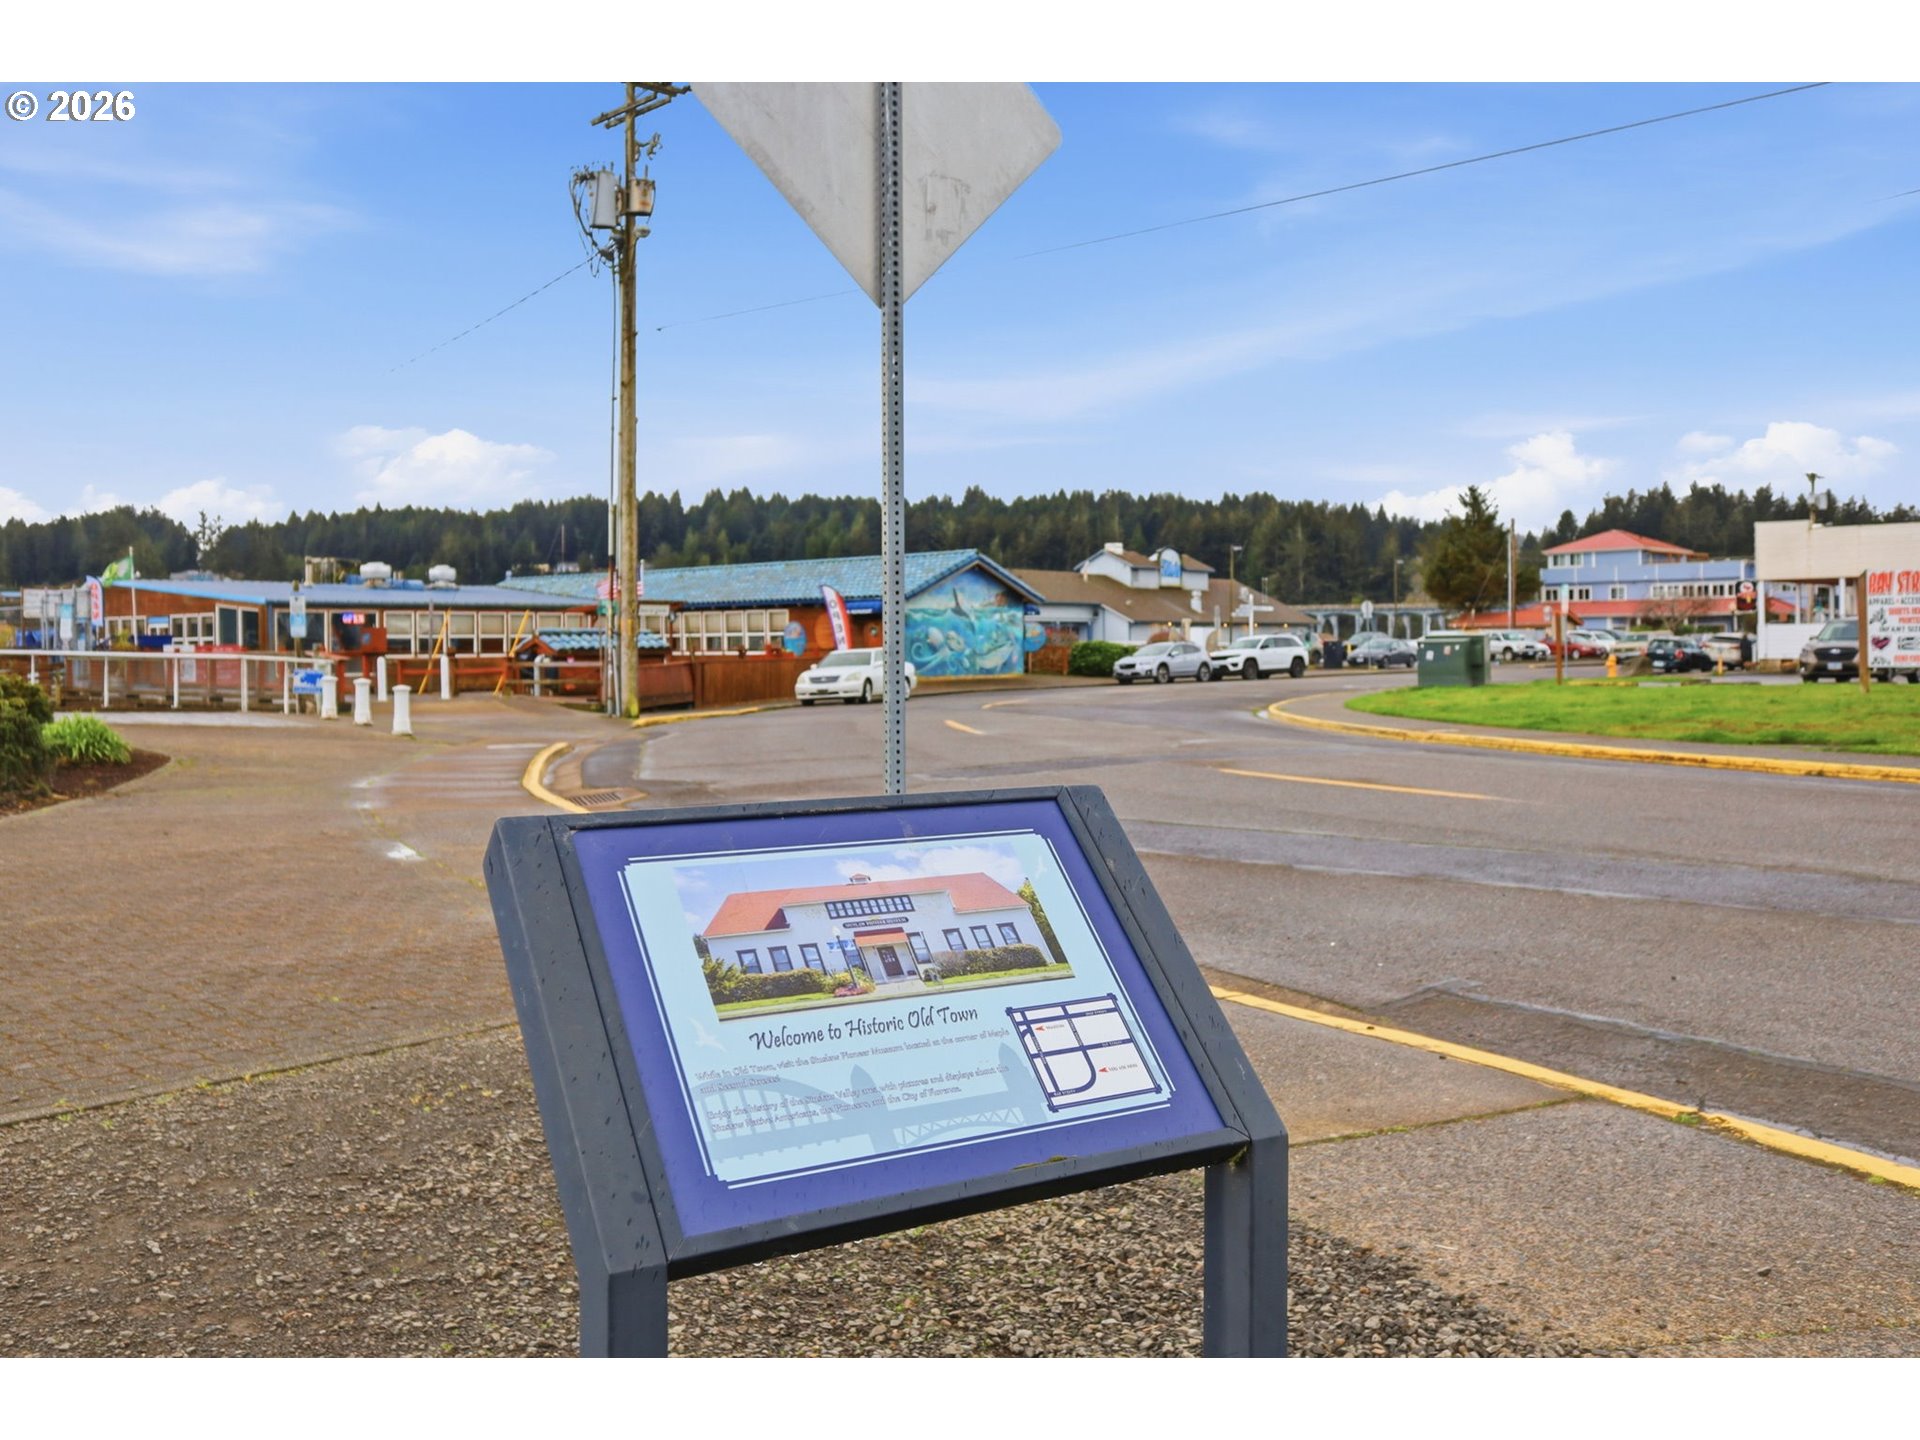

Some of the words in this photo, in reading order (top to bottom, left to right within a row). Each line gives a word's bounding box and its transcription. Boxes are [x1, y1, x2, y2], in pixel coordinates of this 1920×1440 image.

[749, 1026, 824, 1050] Welcome
[828, 1023, 842, 1040] to
[844, 1016, 904, 1038] Historic
[908, 1006, 935, 1028] Old
[936, 1006, 978, 1024] Town
[733, 1066, 748, 1076] Old
[750, 1064, 777, 1073] Town,
[798, 1058, 810, 1068] the
[904, 1039, 930, 1050] located
[941, 1036, 954, 1045] the
[979, 1030, 988, 1040] of
[733, 1106, 747, 1116] the
[779, 1098, 788, 1108] of
[789, 1096, 804, 1106] the
[835, 1087, 862, 1100] Valley
[880, 1082, 898, 1092] with
[898, 1077, 930, 1090] pictures
[930, 1074, 944, 1084] and
[945, 1070, 974, 1082] displays
[975, 1066, 996, 1078] about
[996, 1064, 1010, 1074] the
[820, 1106, 834, 1115] the
[872, 1096, 886, 1107] and
[887, 1094, 901, 1104] the
[902, 1092, 918, 1102] City
[919, 1088, 928, 1098] of
